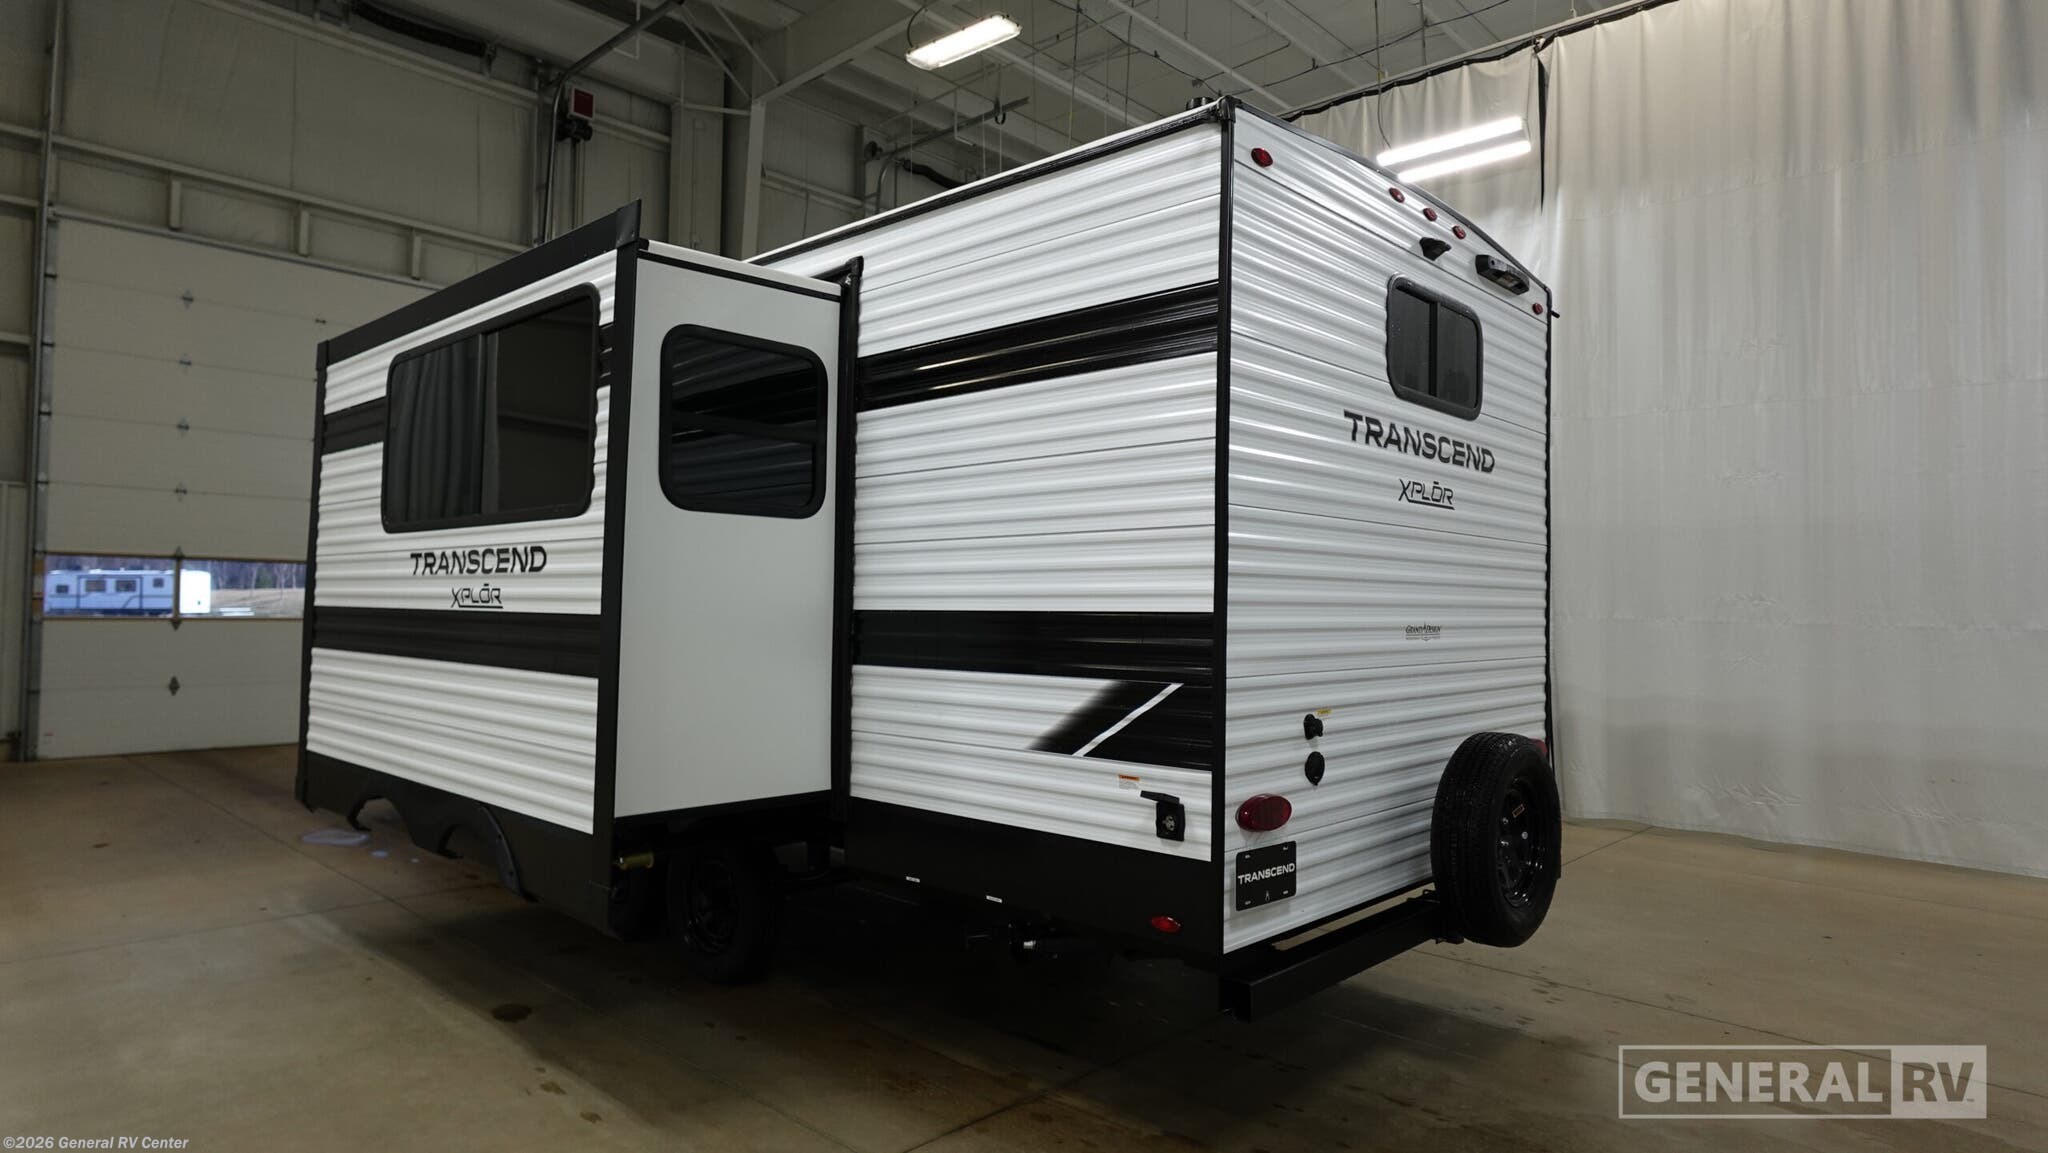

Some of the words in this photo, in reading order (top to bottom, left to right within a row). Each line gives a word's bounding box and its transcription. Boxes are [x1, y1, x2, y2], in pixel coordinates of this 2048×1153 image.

[1343, 409, 1495, 473] TRANSCEND
[410, 546, 547, 575] TRANSCEND
[1238, 863, 1295, 884] TRANSCEND
